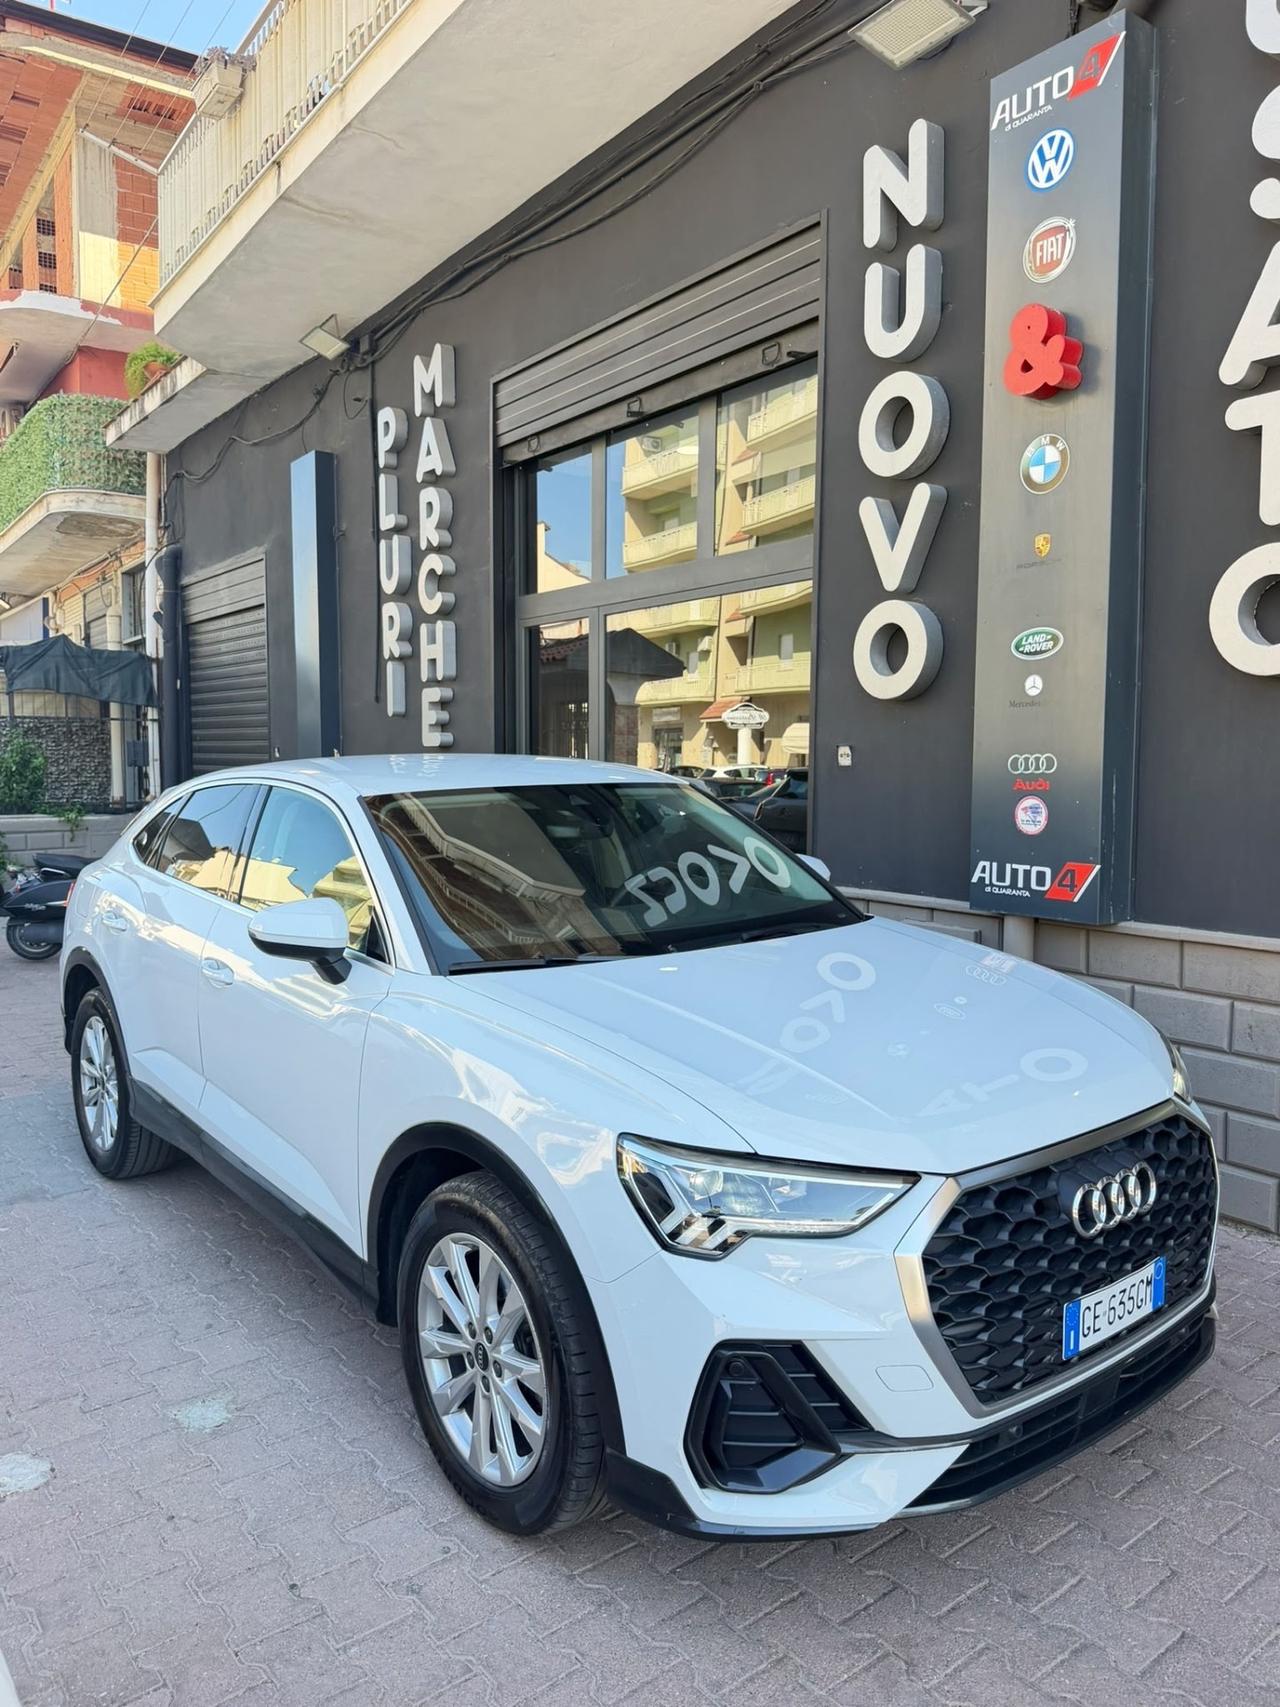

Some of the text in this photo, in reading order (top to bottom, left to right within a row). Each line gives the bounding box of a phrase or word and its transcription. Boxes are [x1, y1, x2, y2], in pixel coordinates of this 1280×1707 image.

[1036, 233, 1065, 267] FIAT
[853, 117, 950, 701] NUOVO
[377, 406, 414, 717] PLURI
[413, 343, 457, 748] MARCHE
[1023, 641, 1054, 653] ROVER
[1012, 778, 1049, 791] Audi
[992, 887, 1031, 898] QUARANTA
